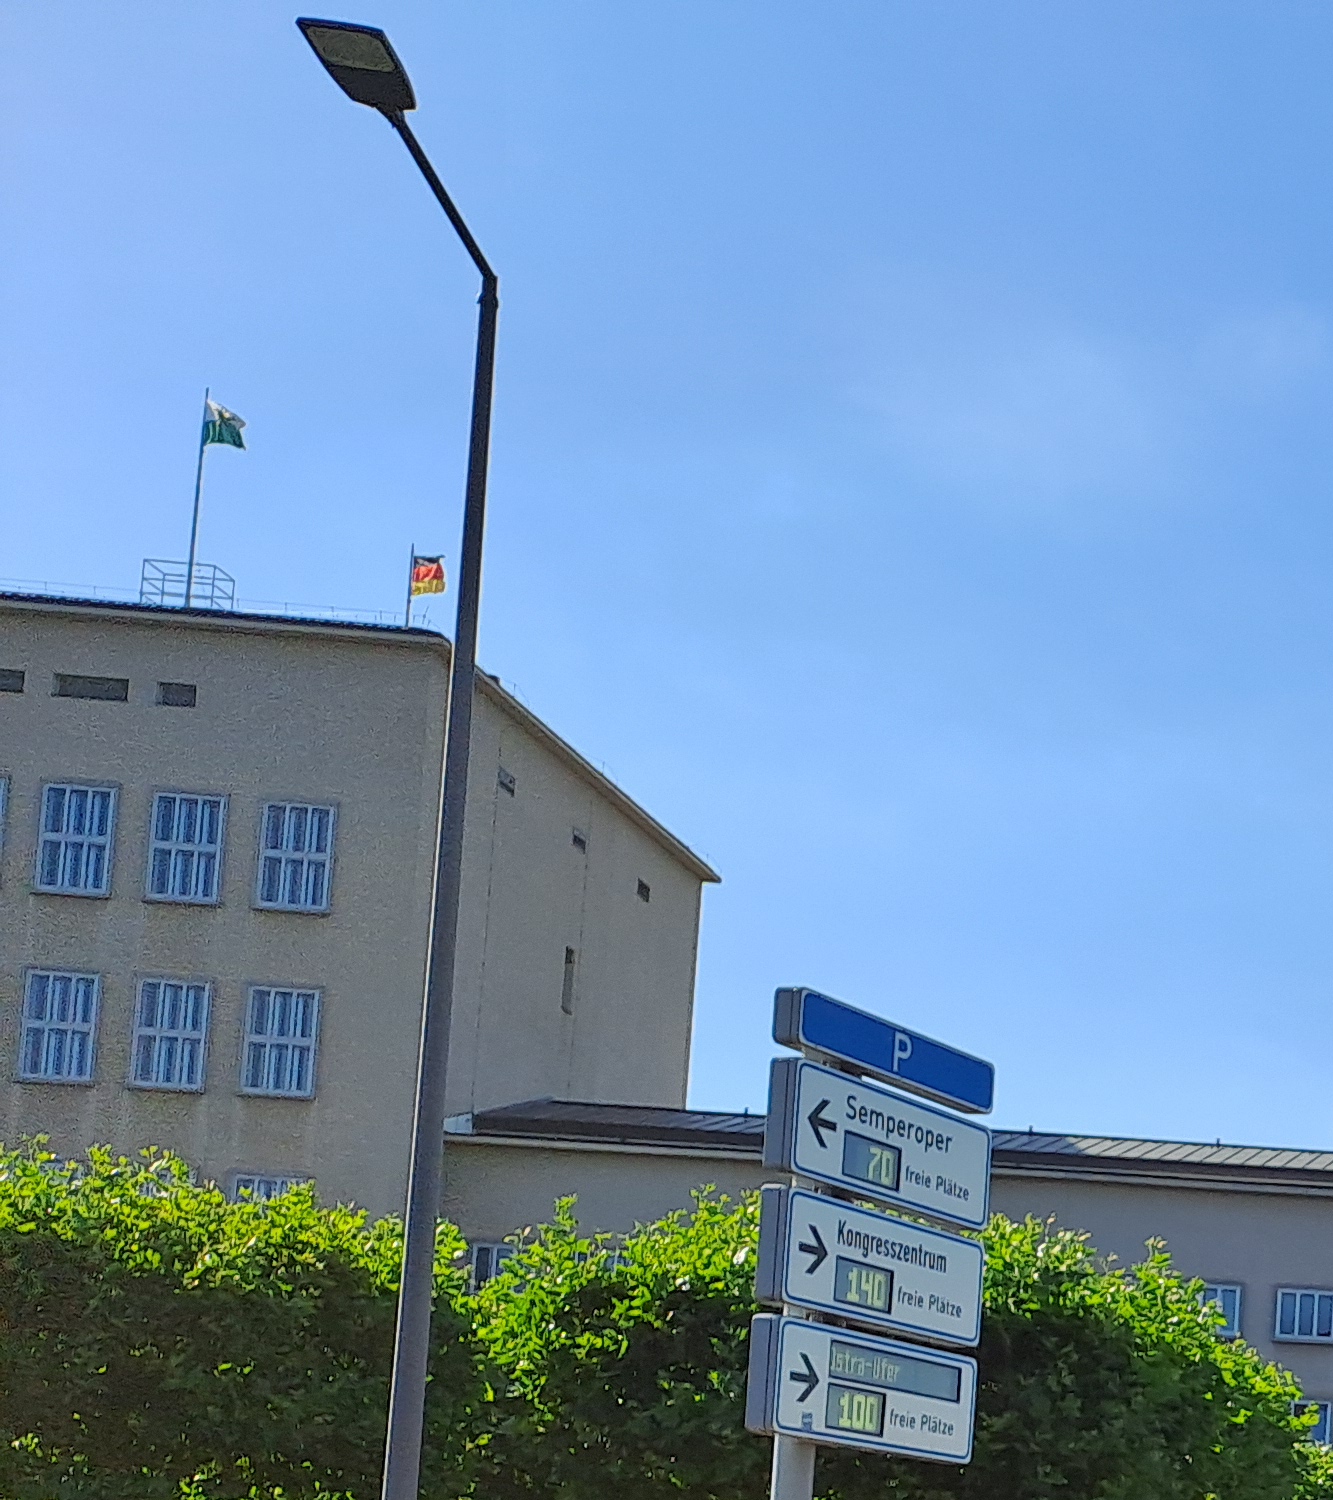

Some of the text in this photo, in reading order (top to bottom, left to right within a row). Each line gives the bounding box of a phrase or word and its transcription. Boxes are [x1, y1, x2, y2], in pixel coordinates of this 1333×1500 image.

[892, 1030, 913, 1073] P
[845, 1094, 953, 1154] Semperoper
[867, 1145, 895, 1187] 70
[905, 1165, 970, 1202] freie Plätze
[836, 1218, 948, 1274] Kongresszentrum
[846, 1266, 887, 1308] 140
[897, 1285, 963, 1319] freie Plätze
[838, 1391, 879, 1432] 100
[889, 1407, 954, 1437] freie Plätze
